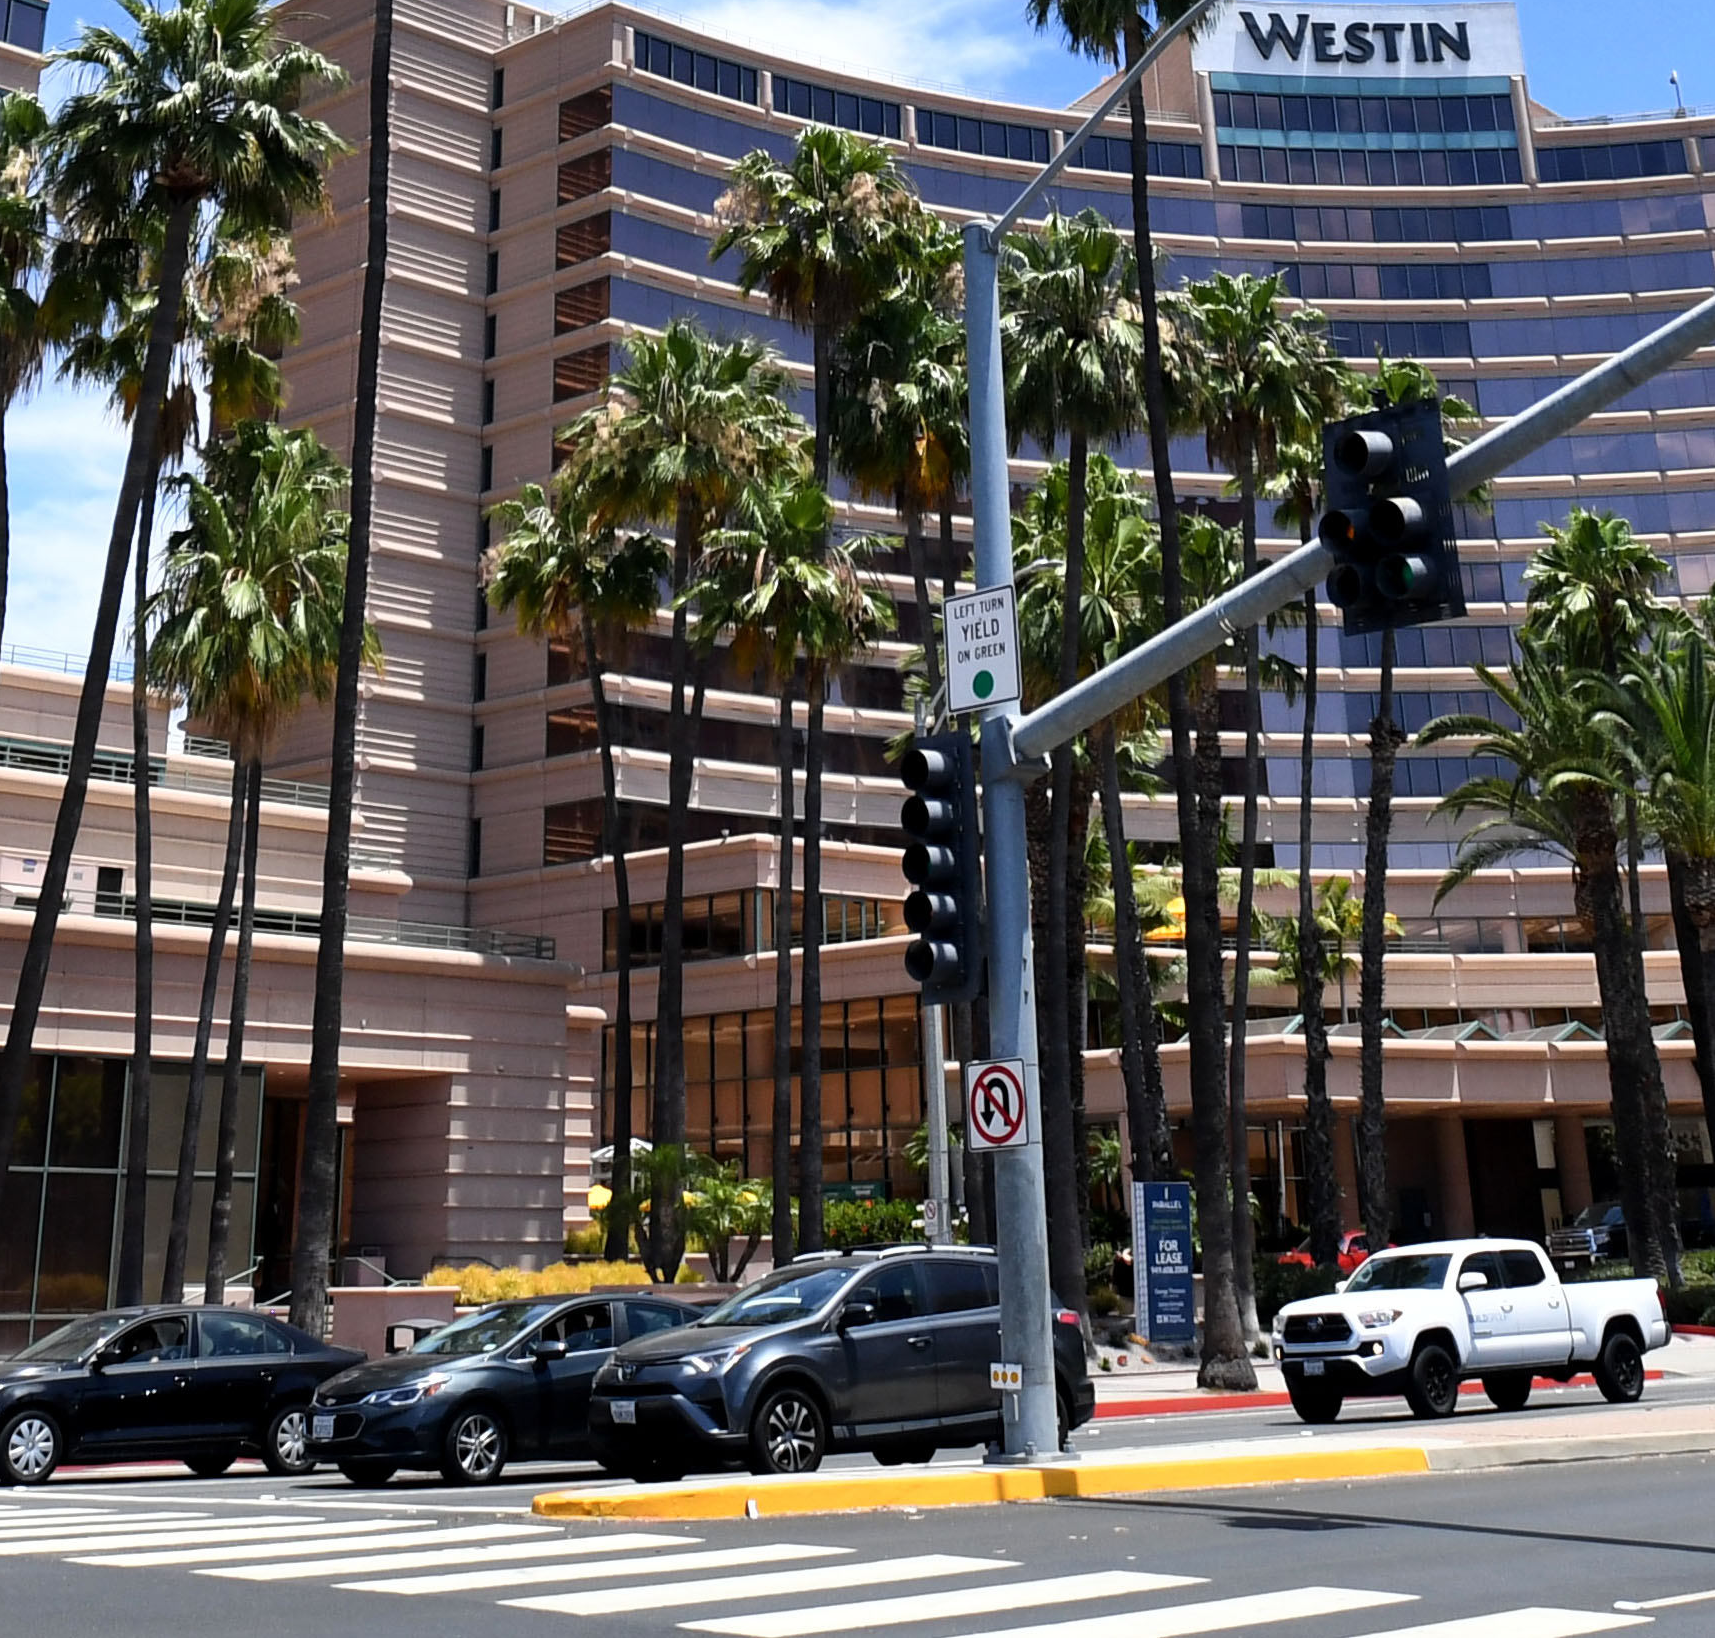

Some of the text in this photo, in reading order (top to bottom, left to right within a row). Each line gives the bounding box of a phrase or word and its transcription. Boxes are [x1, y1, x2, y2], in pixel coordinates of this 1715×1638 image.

[1239, 11, 1471, 63] WESTIN
[954, 597, 1005, 620] LEFT TURN
[961, 618, 1000, 642] YIELD
[958, 642, 1006, 664] ON GREEN
[1158, 1239, 1178, 1252] FOR
[1155, 1251, 1183, 1265] LEASE
